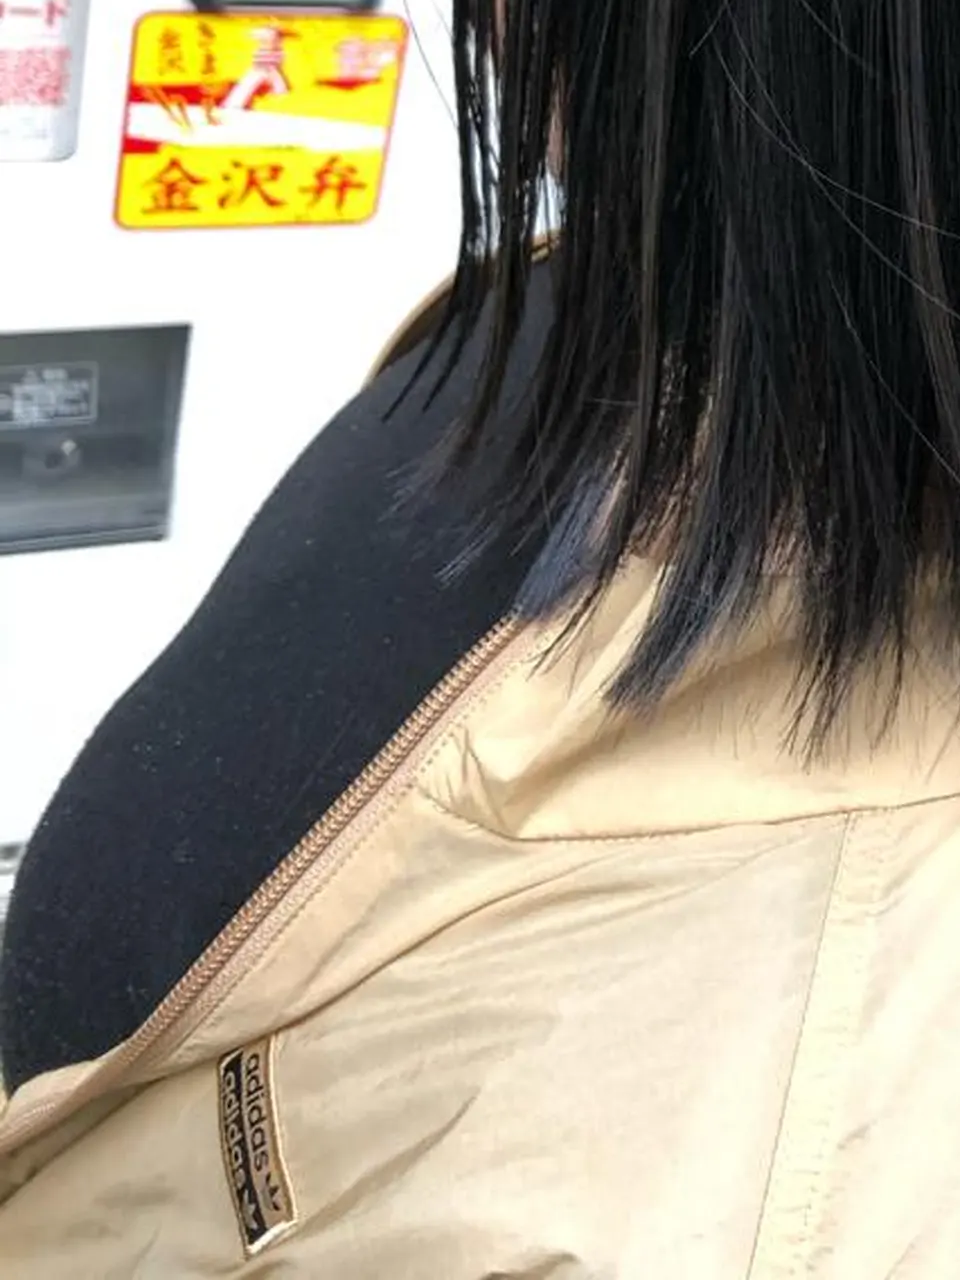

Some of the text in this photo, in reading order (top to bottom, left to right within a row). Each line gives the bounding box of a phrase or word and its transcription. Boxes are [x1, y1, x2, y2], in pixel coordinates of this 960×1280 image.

[139, 155, 368, 216] 金沢弁
[220, 1070, 248, 1192] adidas
[243, 1052, 270, 1173] adidas
